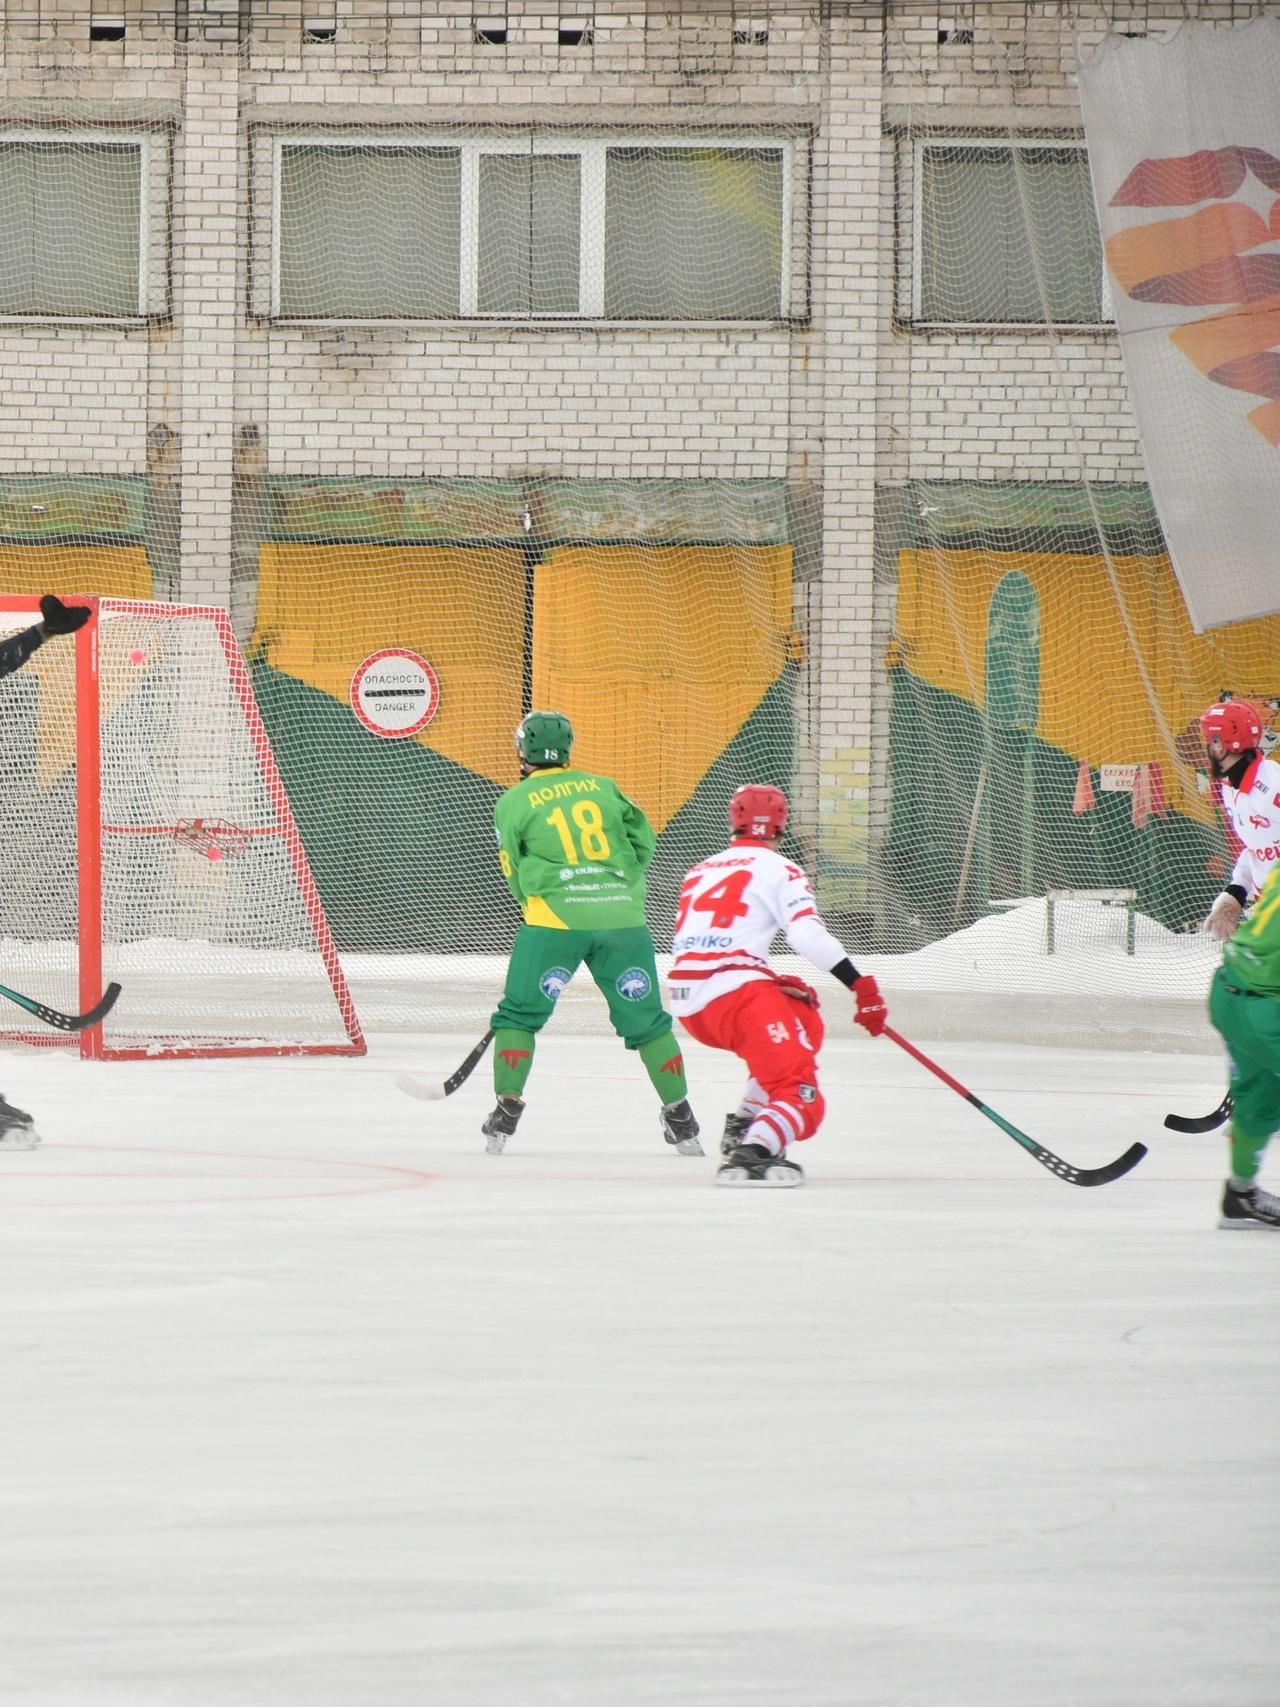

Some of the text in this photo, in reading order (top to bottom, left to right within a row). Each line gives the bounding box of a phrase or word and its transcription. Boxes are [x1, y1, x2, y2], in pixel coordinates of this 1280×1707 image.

[365, 675, 425, 684] ОПАСНОСТЬ
[375, 703, 415, 711] DANGER
[544, 749, 559, 760] 18
[527, 779, 601, 809] ДОЛГИХ
[546, 800, 611, 865] 18
[751, 824, 766, 836] 54
[765, 1021, 791, 1044] 54
